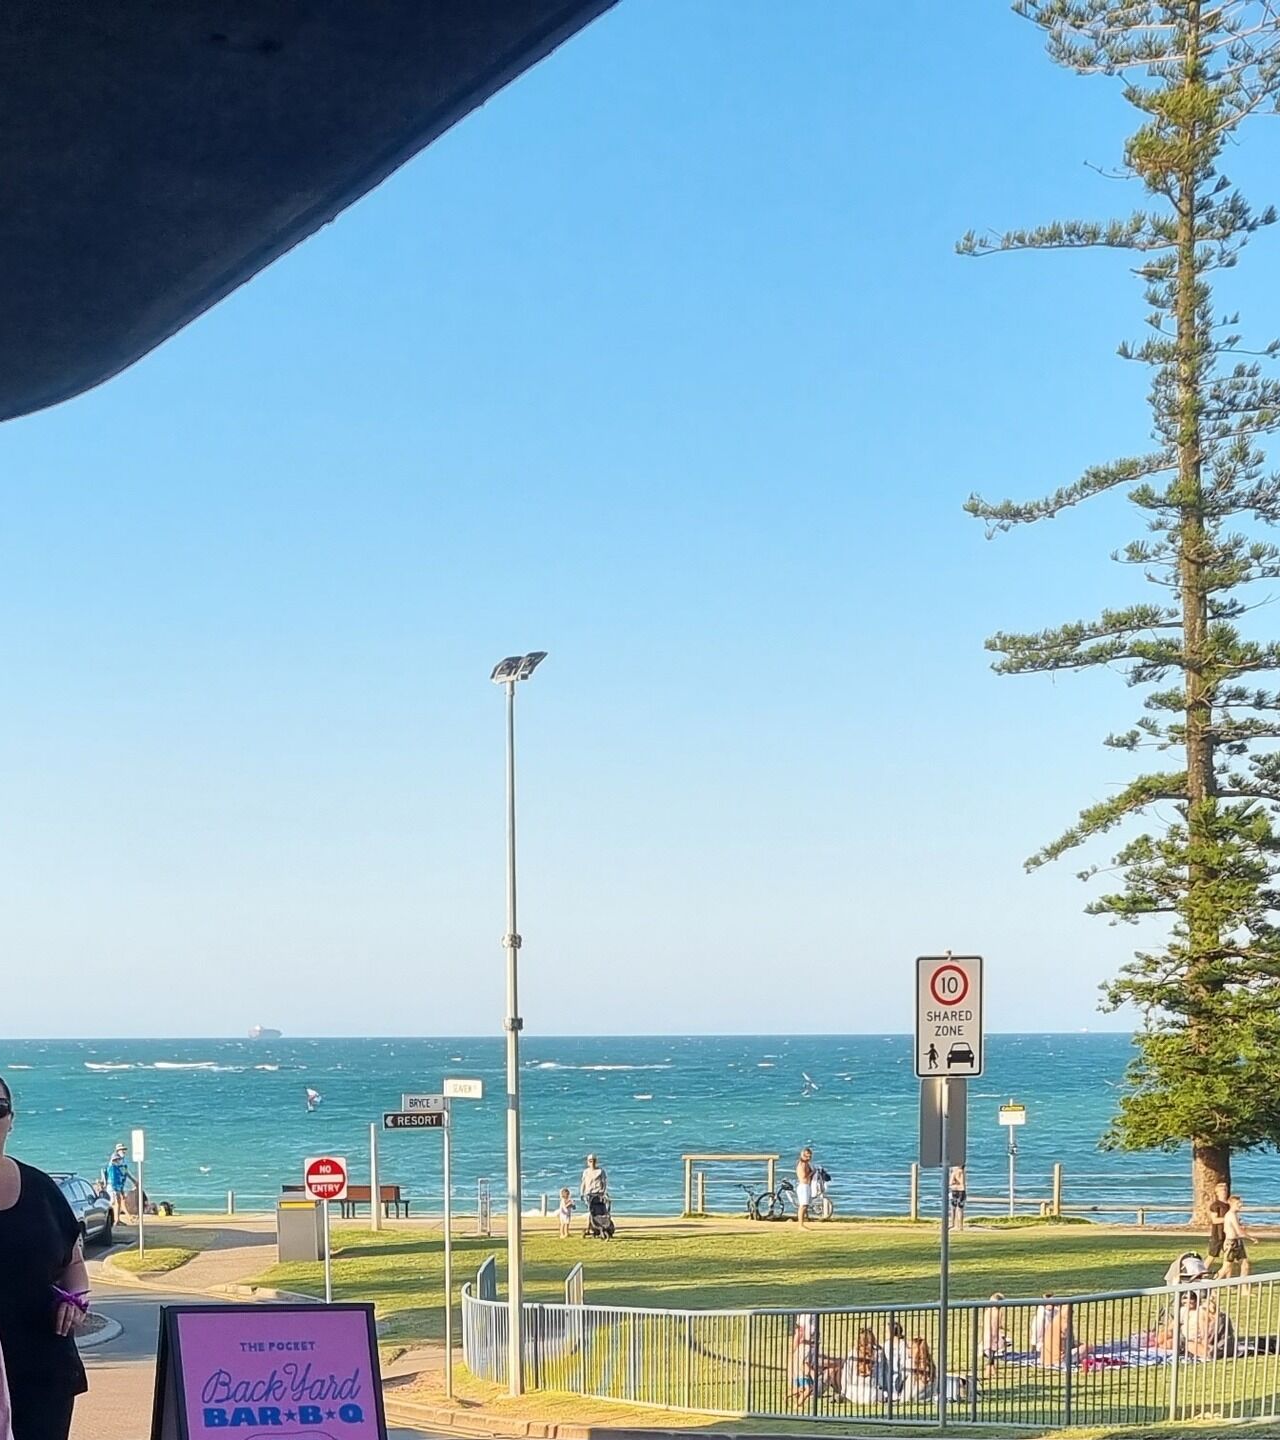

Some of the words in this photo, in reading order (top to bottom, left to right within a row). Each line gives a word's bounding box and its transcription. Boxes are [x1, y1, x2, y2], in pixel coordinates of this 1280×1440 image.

[942, 976, 958, 994] 10
[926, 1010, 973, 1022] SHARED
[935, 1025, 965, 1037] ZONE
[409, 1098, 431, 1108] BRYCE
[397, 1115, 438, 1126] RESORT
[319, 1165, 332, 1174] NO
[311, 1184, 340, 1193] ENTRY
[240, 1342, 265, 1352] THE
[268, 1341, 316, 1351] POCKET
[201, 1368, 287, 1404] Back
[283, 1362, 361, 1402] Yard
